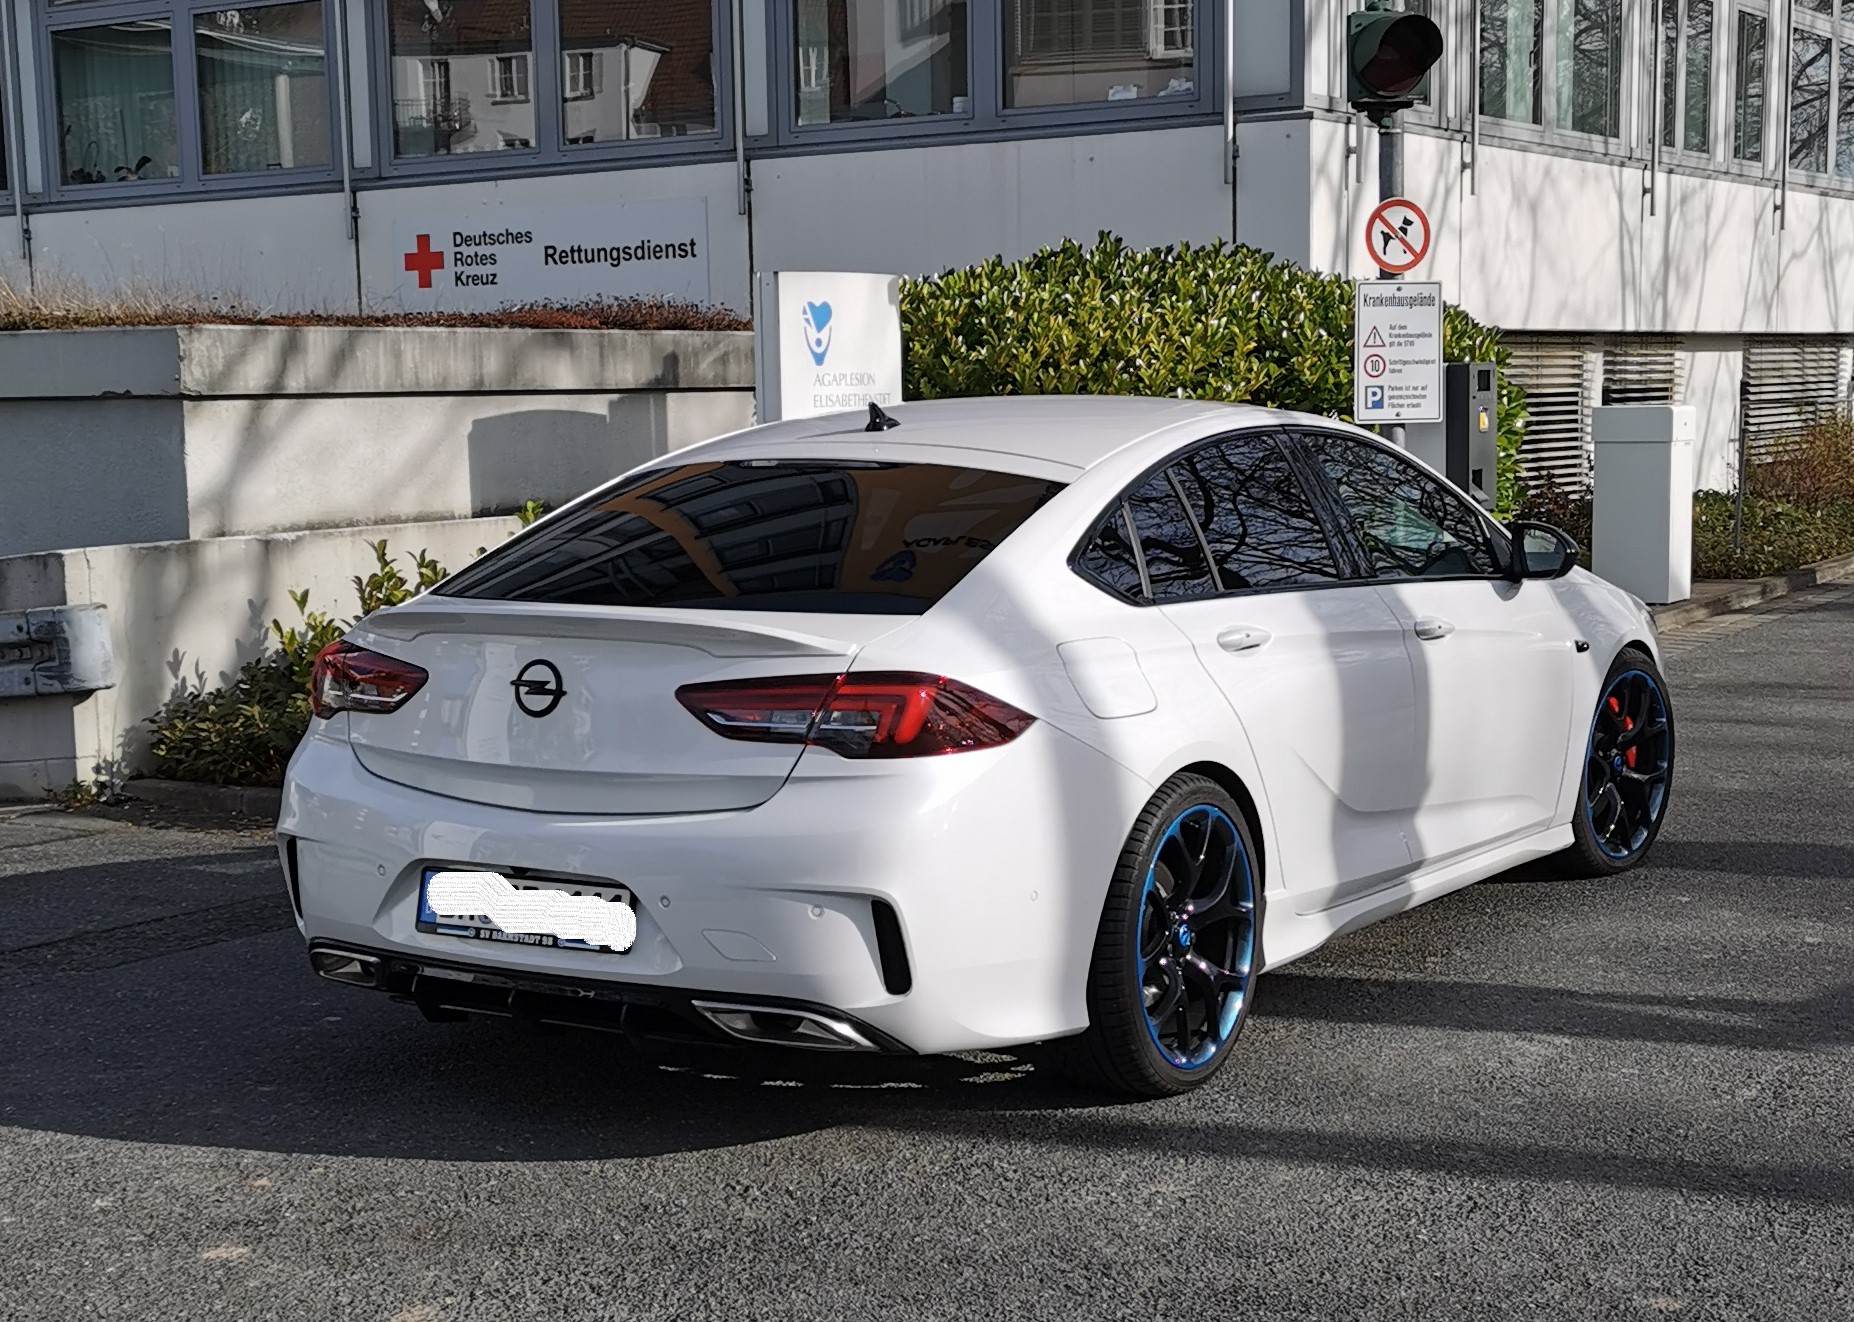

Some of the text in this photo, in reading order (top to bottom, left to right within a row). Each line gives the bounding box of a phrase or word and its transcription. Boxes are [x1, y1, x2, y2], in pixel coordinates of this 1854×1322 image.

[453, 228, 533, 247] Deutsches
[453, 250, 497, 267] Rotes
[544, 238, 697, 267] Rettungsdienst
[454, 271, 498, 287] Kreuz
[1363, 292, 1436, 309] Krankenhausgelände
[1370, 359, 1380, 373] 10
[813, 372, 876, 387] AGAPLESION
[479, 929, 491, 939] SV
